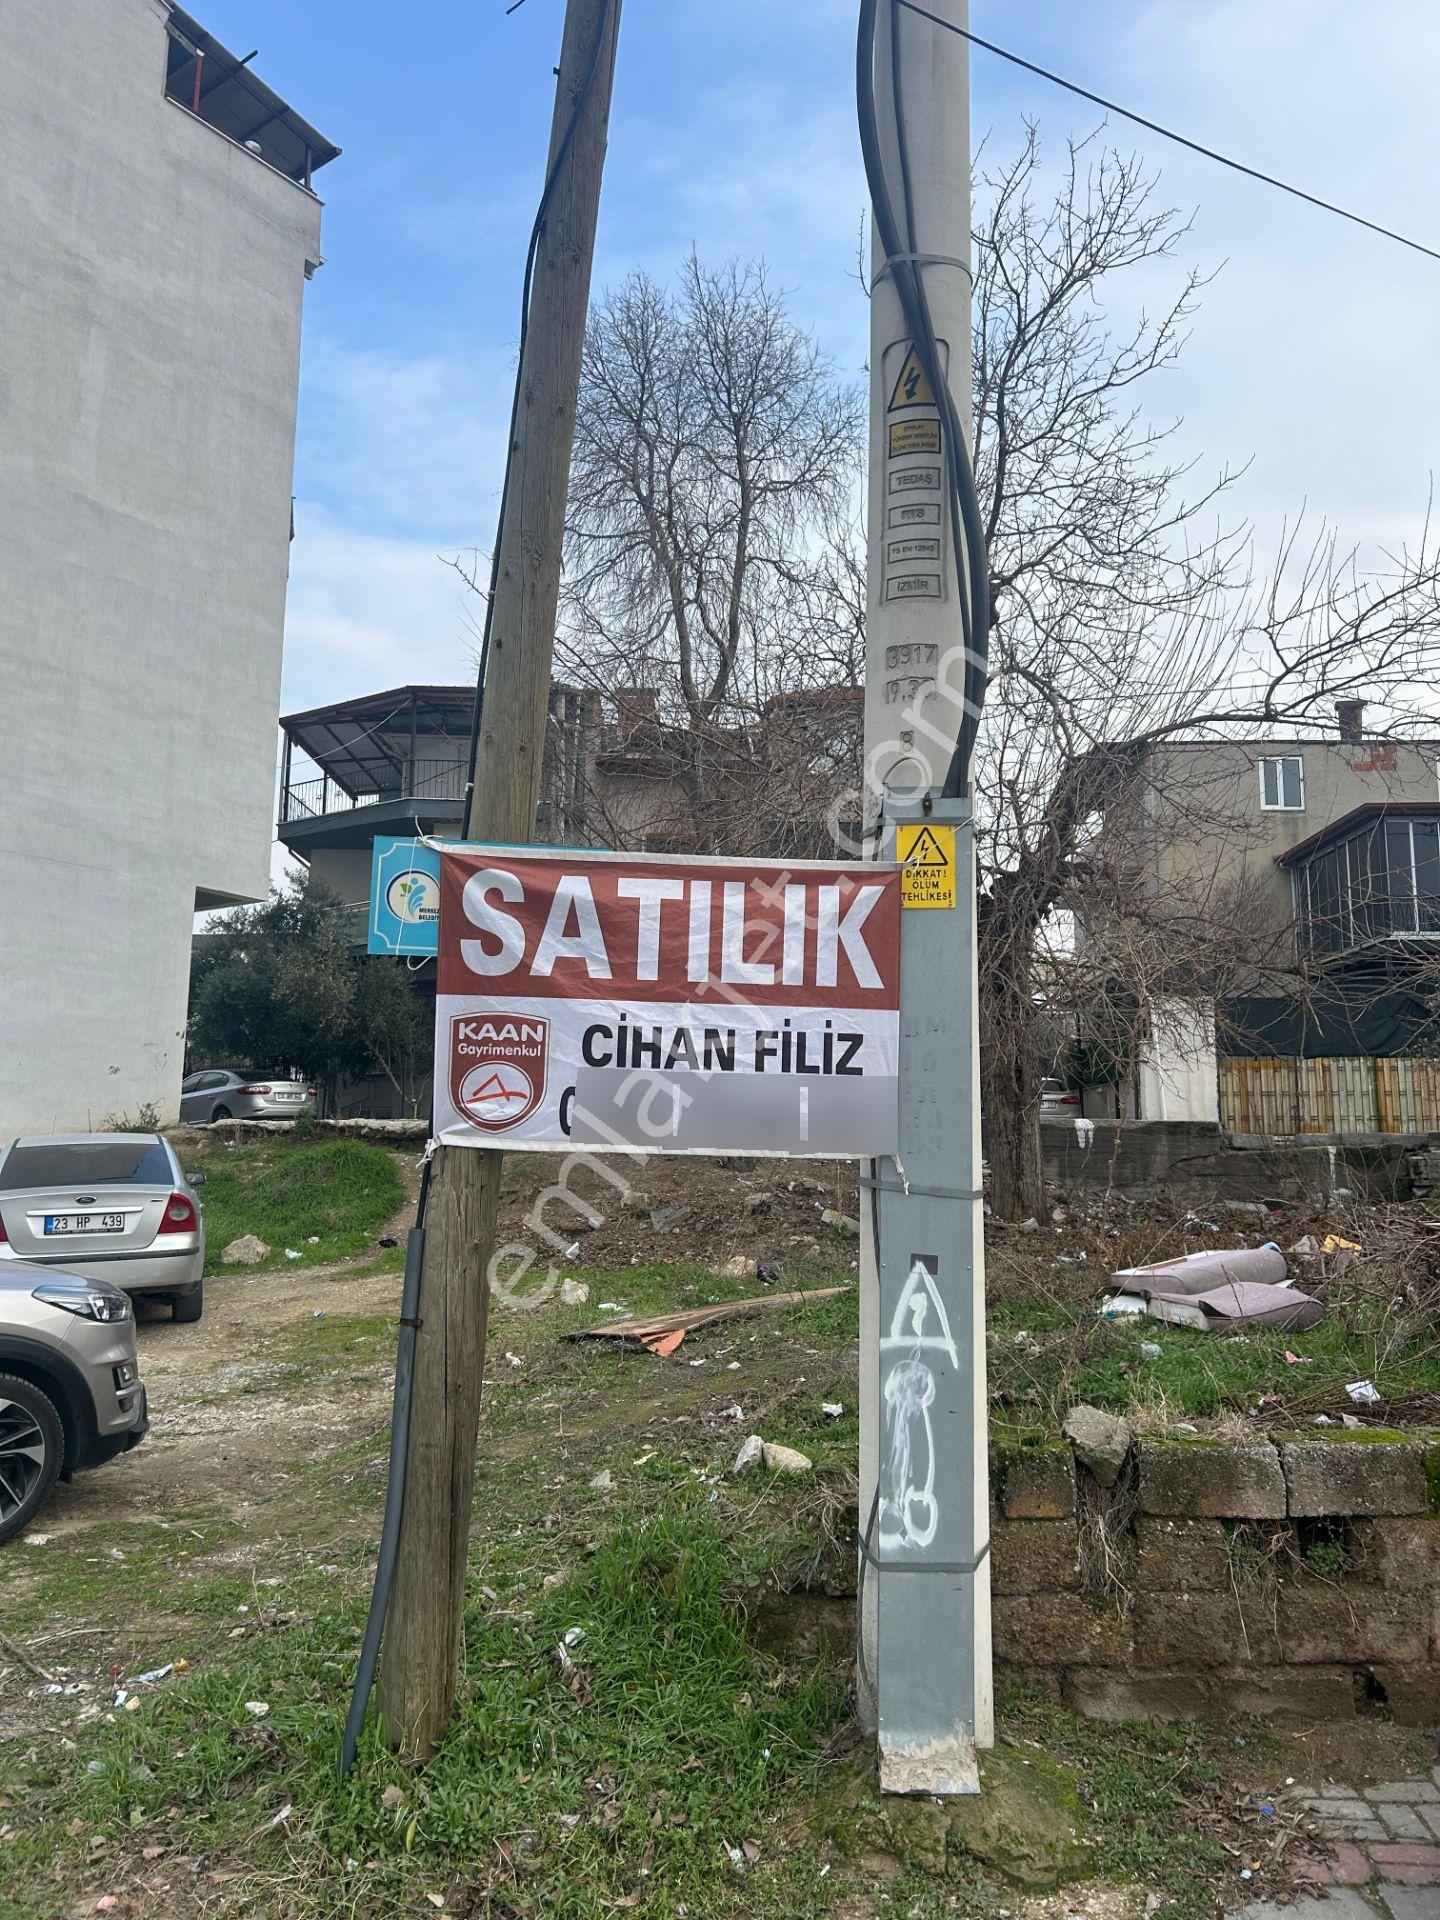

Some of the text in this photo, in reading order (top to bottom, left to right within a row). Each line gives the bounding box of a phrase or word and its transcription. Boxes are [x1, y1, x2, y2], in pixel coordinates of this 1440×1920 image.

[887, 646, 937, 669] 3917
[912, 879, 939, 889] ÖLÜM
[460, 868, 886, 990] SATILIK
[458, 1022, 544, 1042] KAAN
[457, 1043, 541, 1057] Gayrimenkul
[582, 1013, 864, 1076] CİHAN FİLİZ
[54, 1215, 122, 1230] 23 HP 439
